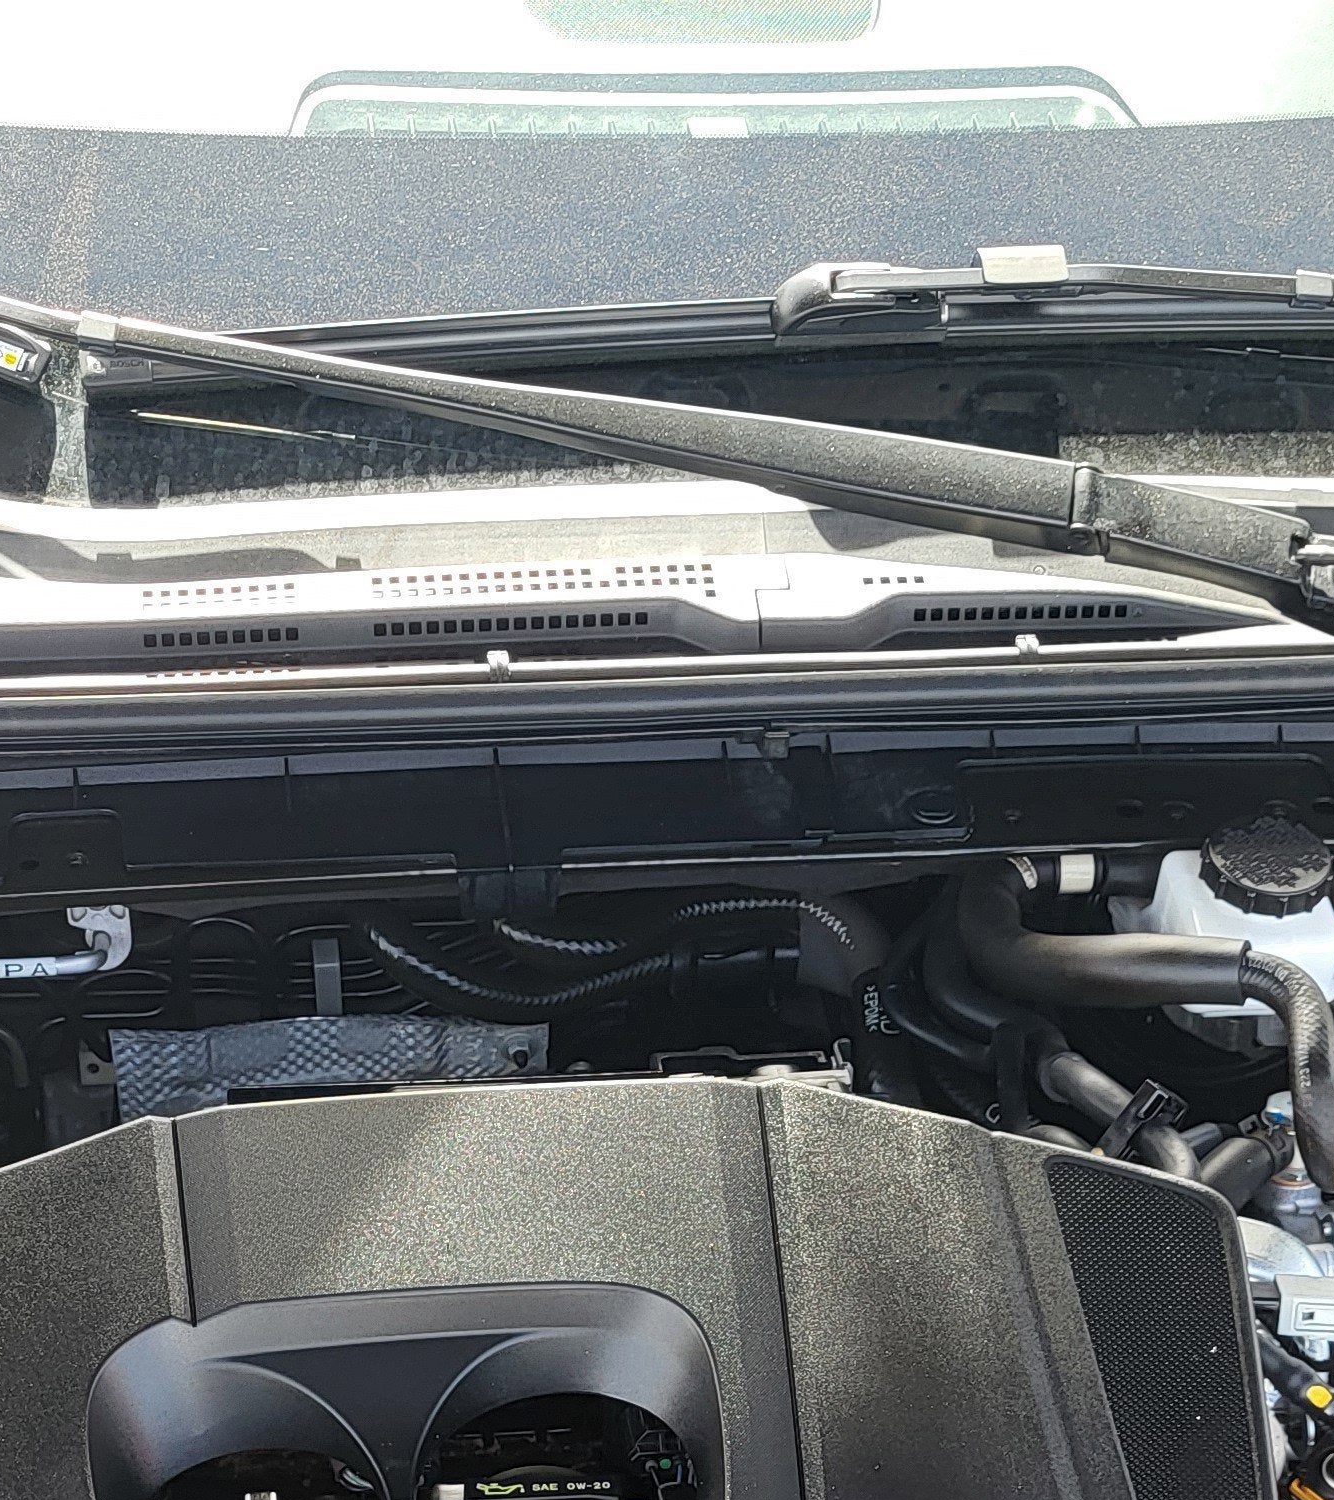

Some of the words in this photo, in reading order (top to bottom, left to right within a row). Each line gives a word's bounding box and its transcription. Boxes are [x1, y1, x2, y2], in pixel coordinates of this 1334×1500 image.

[109, 358, 145, 369] BOSCH
[532, 1482, 559, 1492] SAE
[566, 1480, 611, 1491] 0W-20
